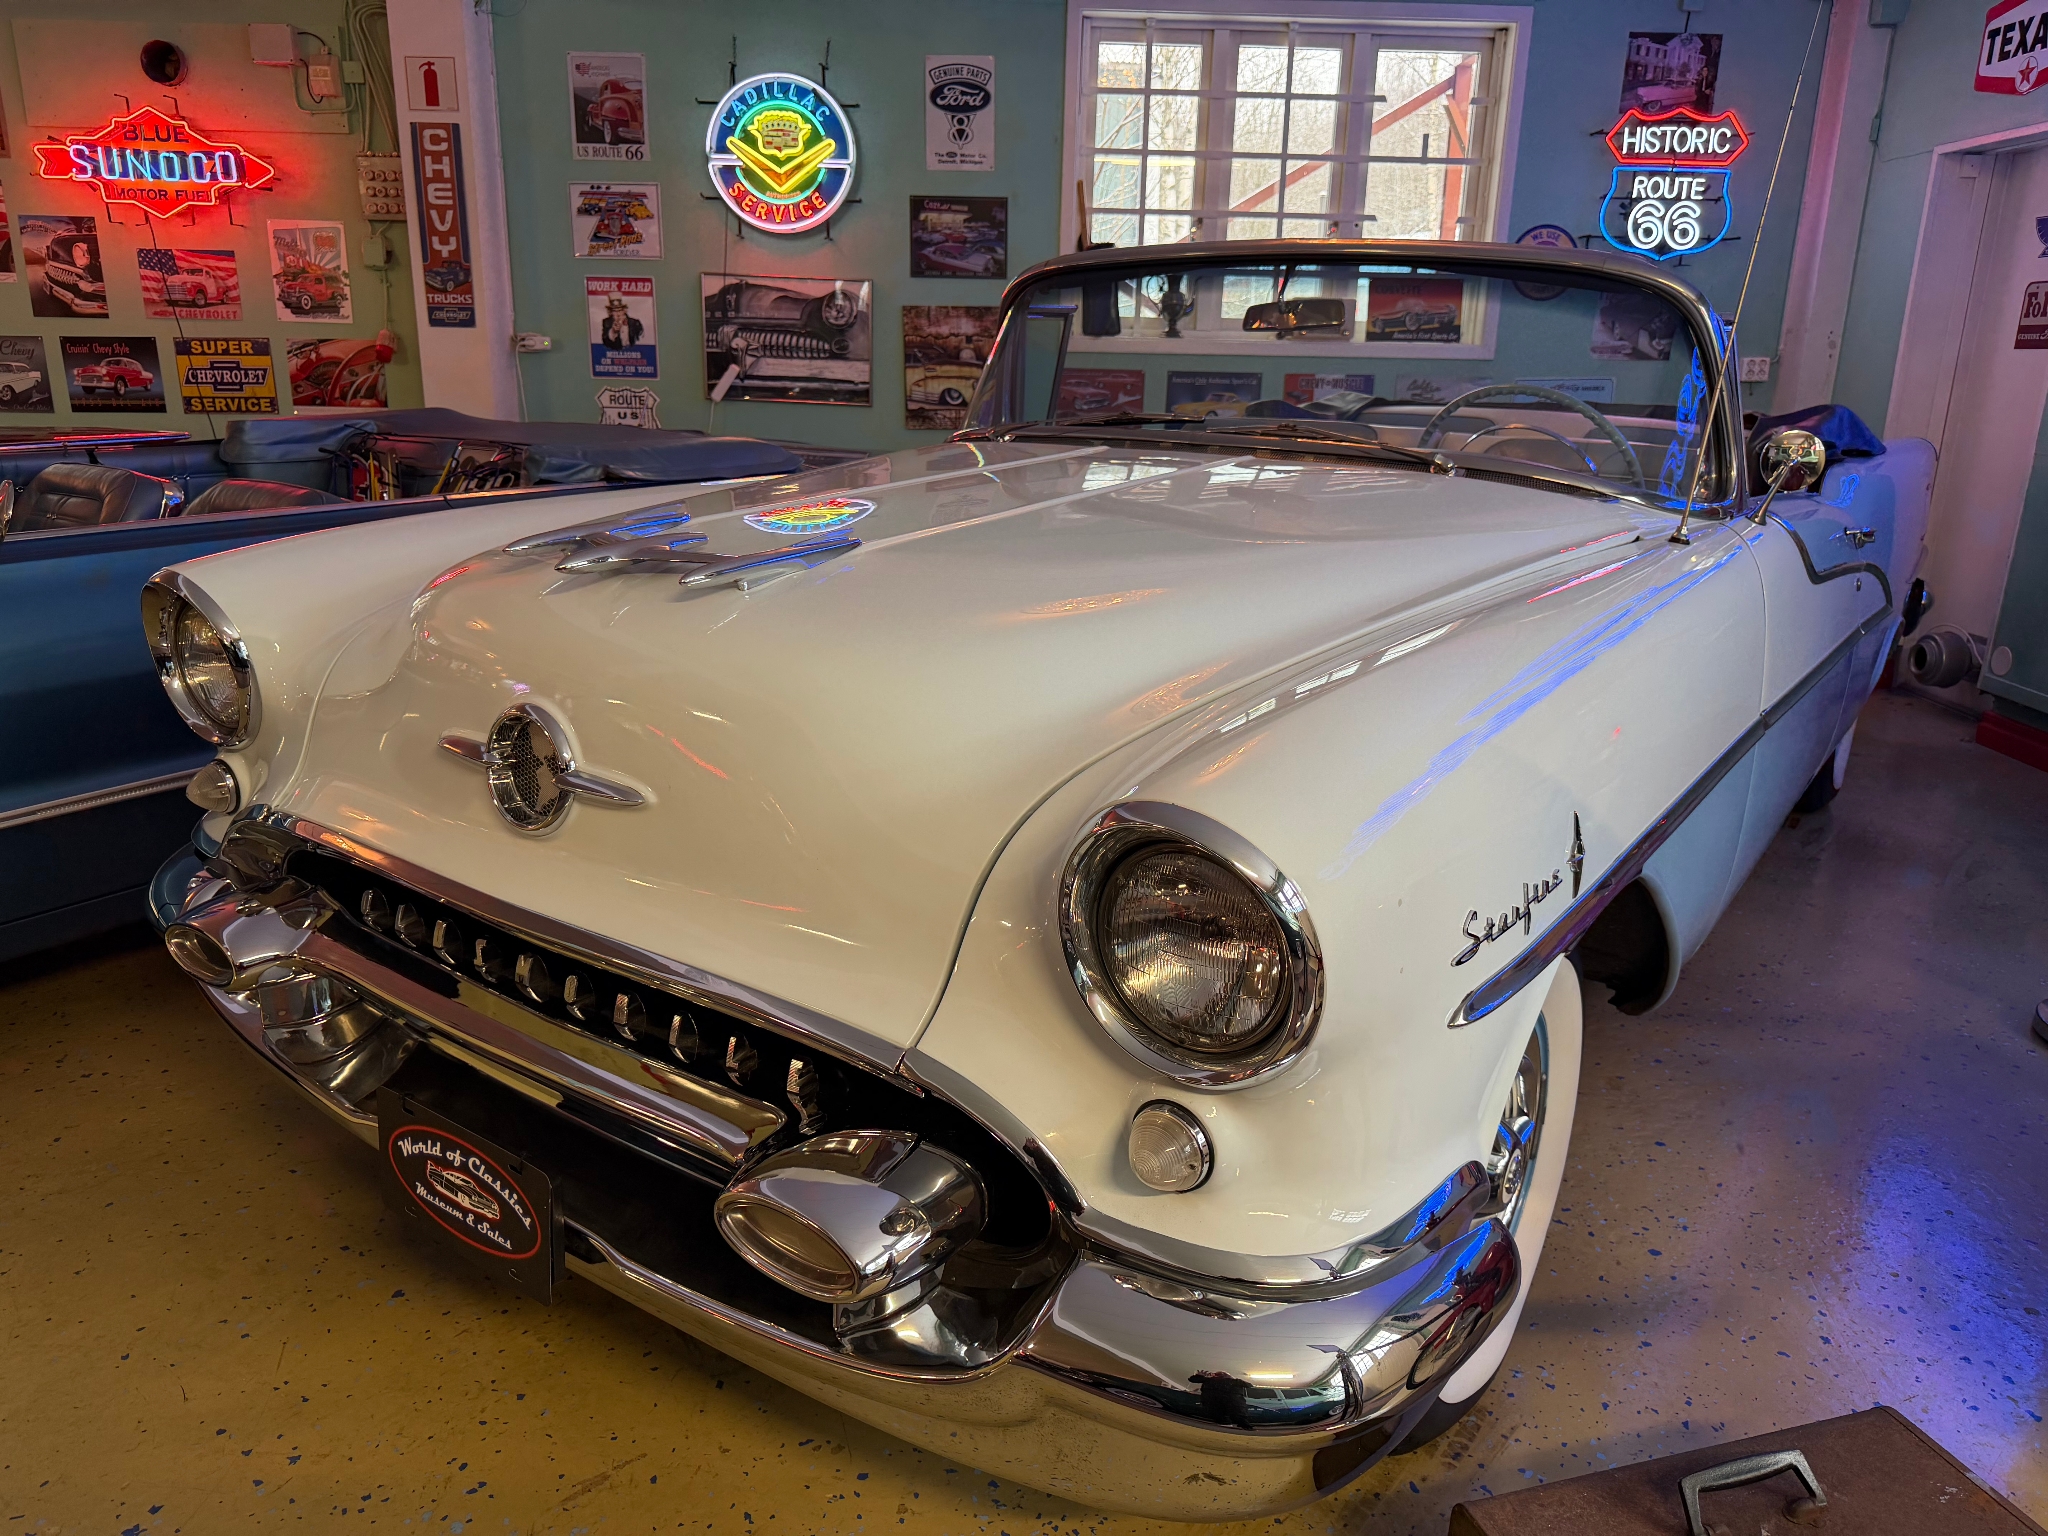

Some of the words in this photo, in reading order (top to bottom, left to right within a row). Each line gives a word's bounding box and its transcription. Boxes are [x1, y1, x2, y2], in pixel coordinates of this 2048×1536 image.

[1986, 11, 2048, 66] TEXA
[933, 66, 964, 80] GENUINE
[966, 67, 988, 82] PARTS
[936, 84, 984, 106] Ford
[720, 80, 830, 127] CADILLAC
[123, 124, 190, 143] BLUE
[1622, 125, 1732, 155] HISTORIC
[577, 146, 589, 158] US
[592, 146, 623, 158] ROUTE
[625, 145, 644, 160] 66
[69, 145, 238, 183] SUNOCO
[115, 188, 169, 201] MOTOR
[422, 128, 457, 258] CHEVY
[1631, 175, 1707, 200] ROUTE
[728, 182, 827, 223] SERVICE
[1627, 199, 1701, 250] 66
[1530, 231, 1543, 241] WE
[1546, 230, 1562, 242] USE
[588, 281, 619, 292] WORK
[621, 281, 652, 292] HARD
[427, 293, 473, 304] TRUCKS
[177, 309, 238, 319] CHEVROLET
[0, 339, 35, 360] Chevy
[66, 342, 90, 354] Cruisin'
[92, 343, 112, 356] Chevy
[112, 342, 130, 355] Style
[190, 340, 254, 355] SUPER
[606, 351, 641, 359] MILLIONS
[188, 369, 265, 383] CHEVROLET
[595, 365, 624, 373] DEPEND
[637, 366, 655, 374] YOU!
[1298, 377, 1324, 390] CHEVY
[1331, 377, 1364, 390] MUSCLE
[191, 398, 271, 412] SERVICE
[609, 394, 646, 406] ROUTE
[1450, 868, 1563, 968] Starfire
[397, 1137, 442, 1157] World
[446, 1150, 466, 1166] of
[468, 1157, 532, 1230] Classics
[415, 1182, 464, 1220] Museum
[465, 1213, 475, 1227] &
[477, 1222, 513, 1250] Sales
